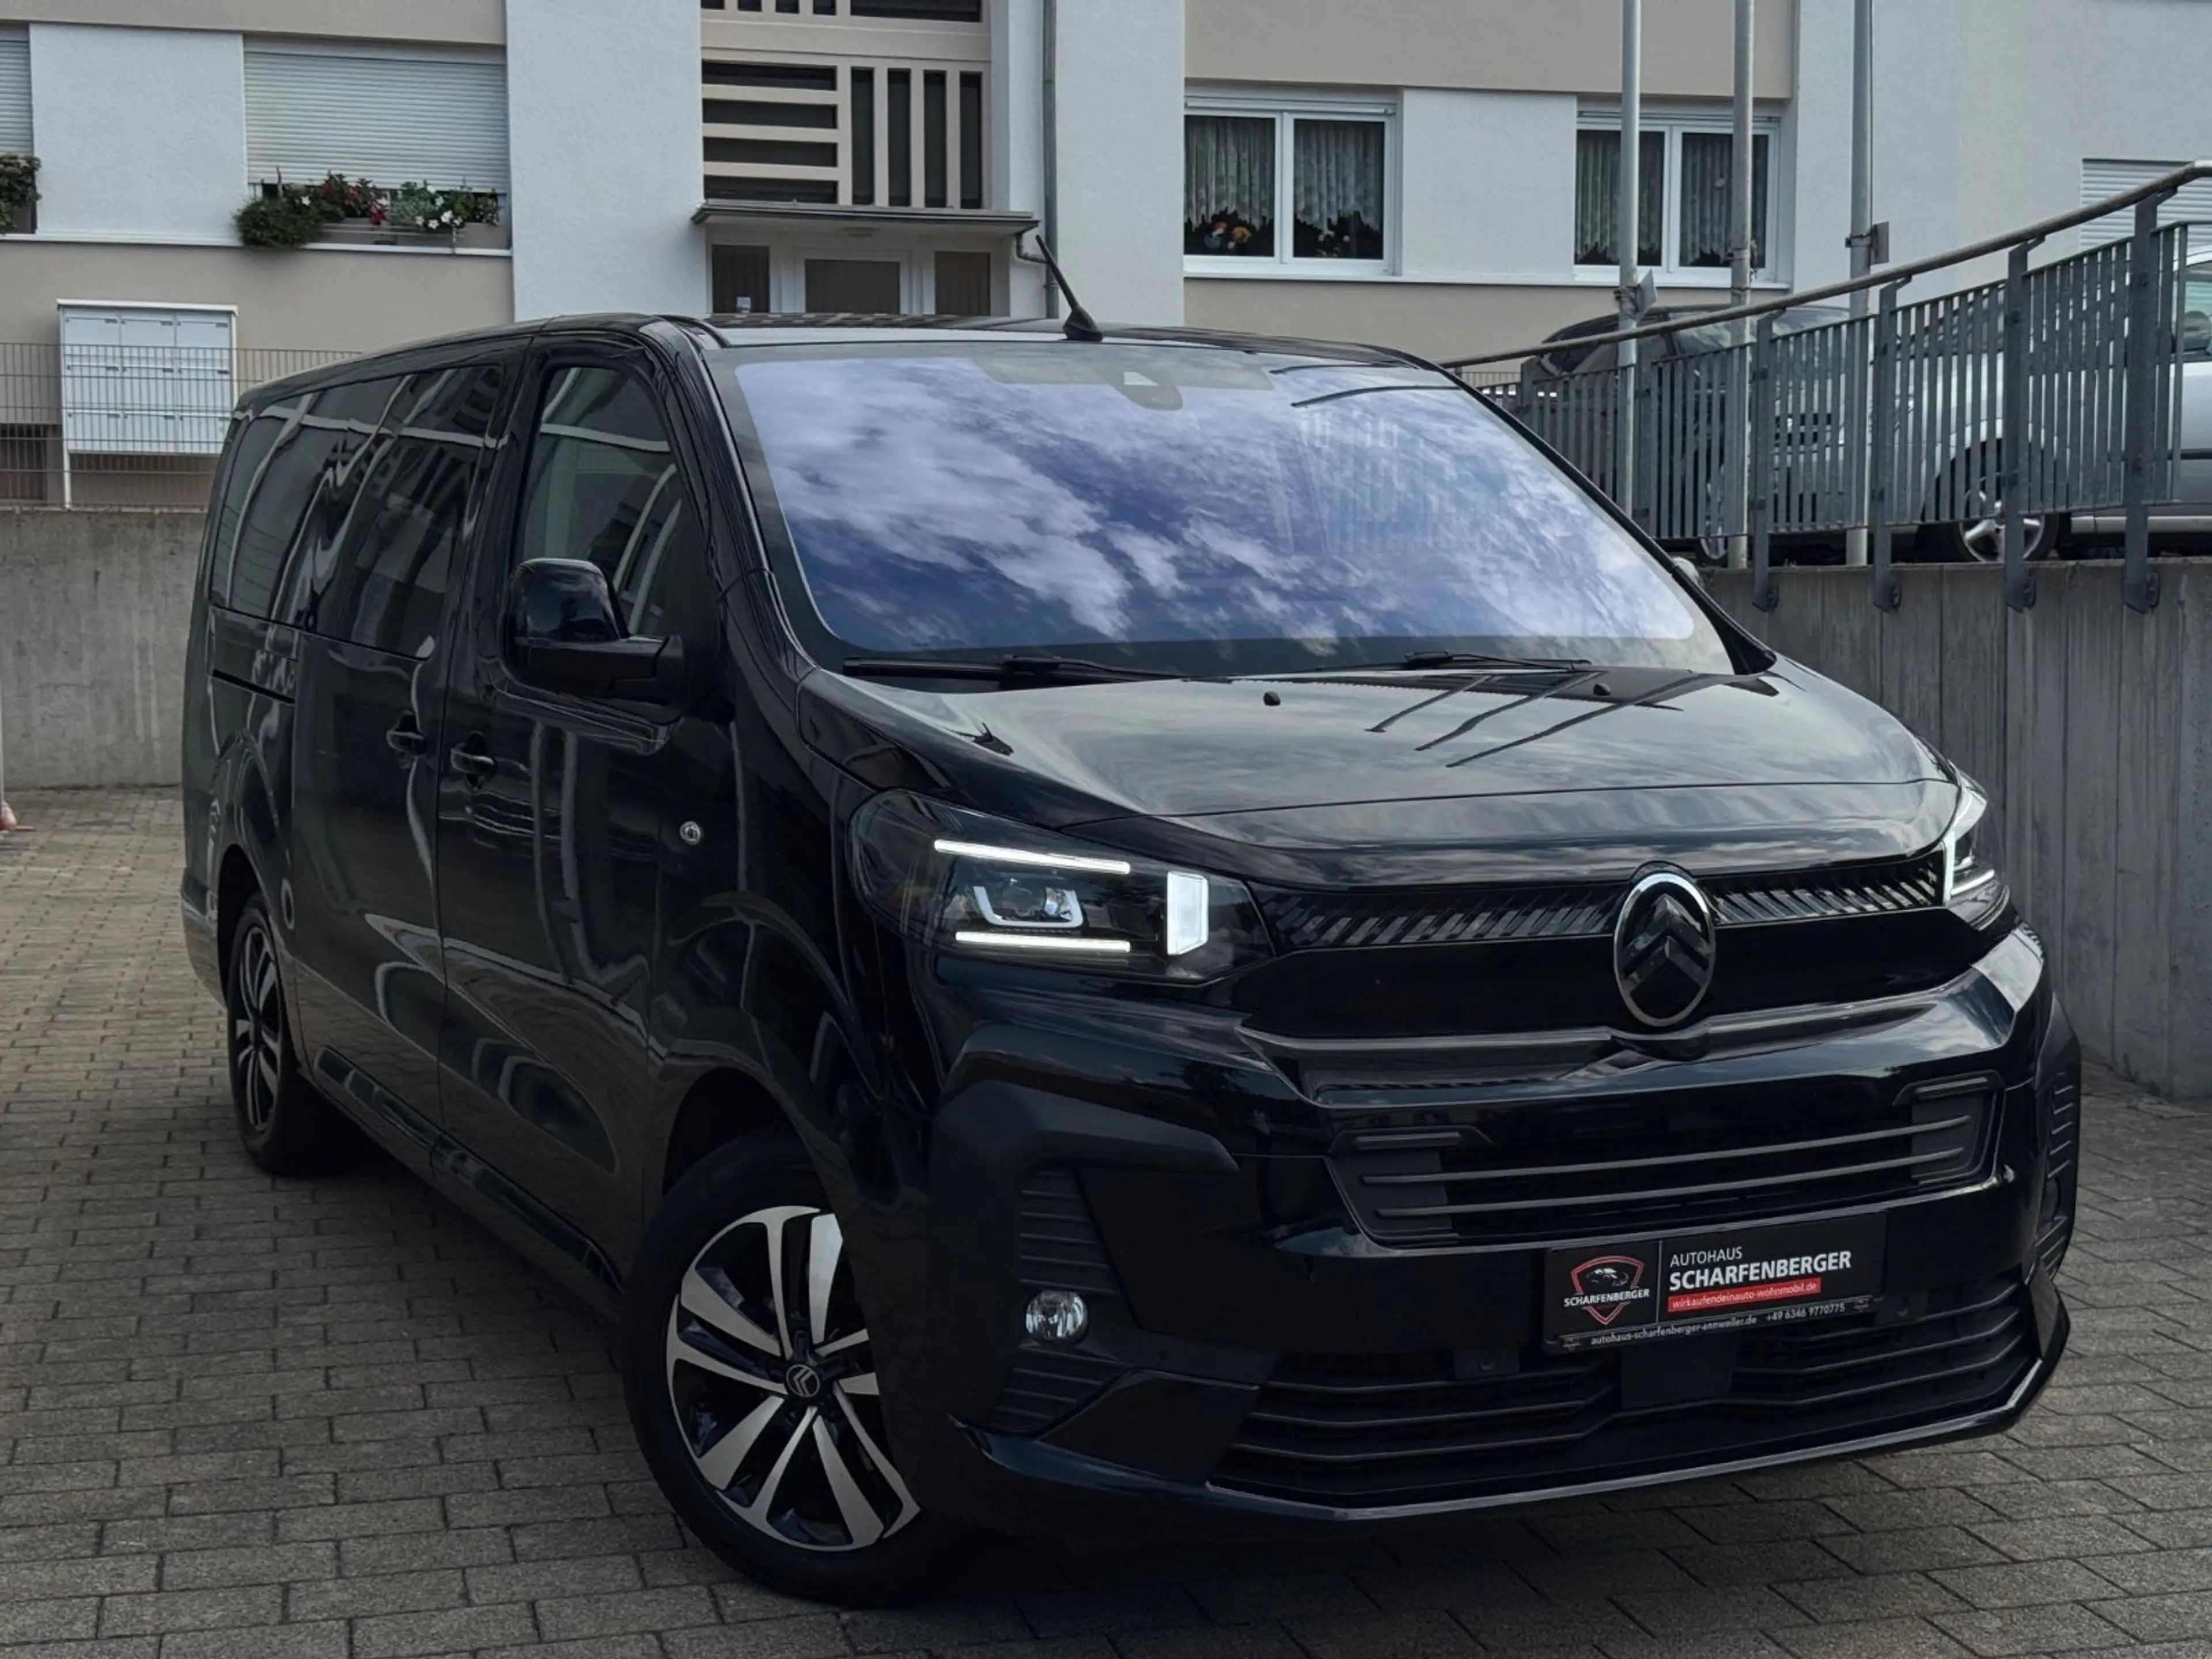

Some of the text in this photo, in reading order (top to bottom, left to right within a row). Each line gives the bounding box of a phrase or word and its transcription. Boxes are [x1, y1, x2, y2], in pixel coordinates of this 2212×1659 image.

[1670, 1246, 1743, 1267] AUTOHAUS
[1669, 1251, 1852, 1291] SCHARFENBERGER
[1563, 1289, 1650, 1307] SCHARFENBERGER
